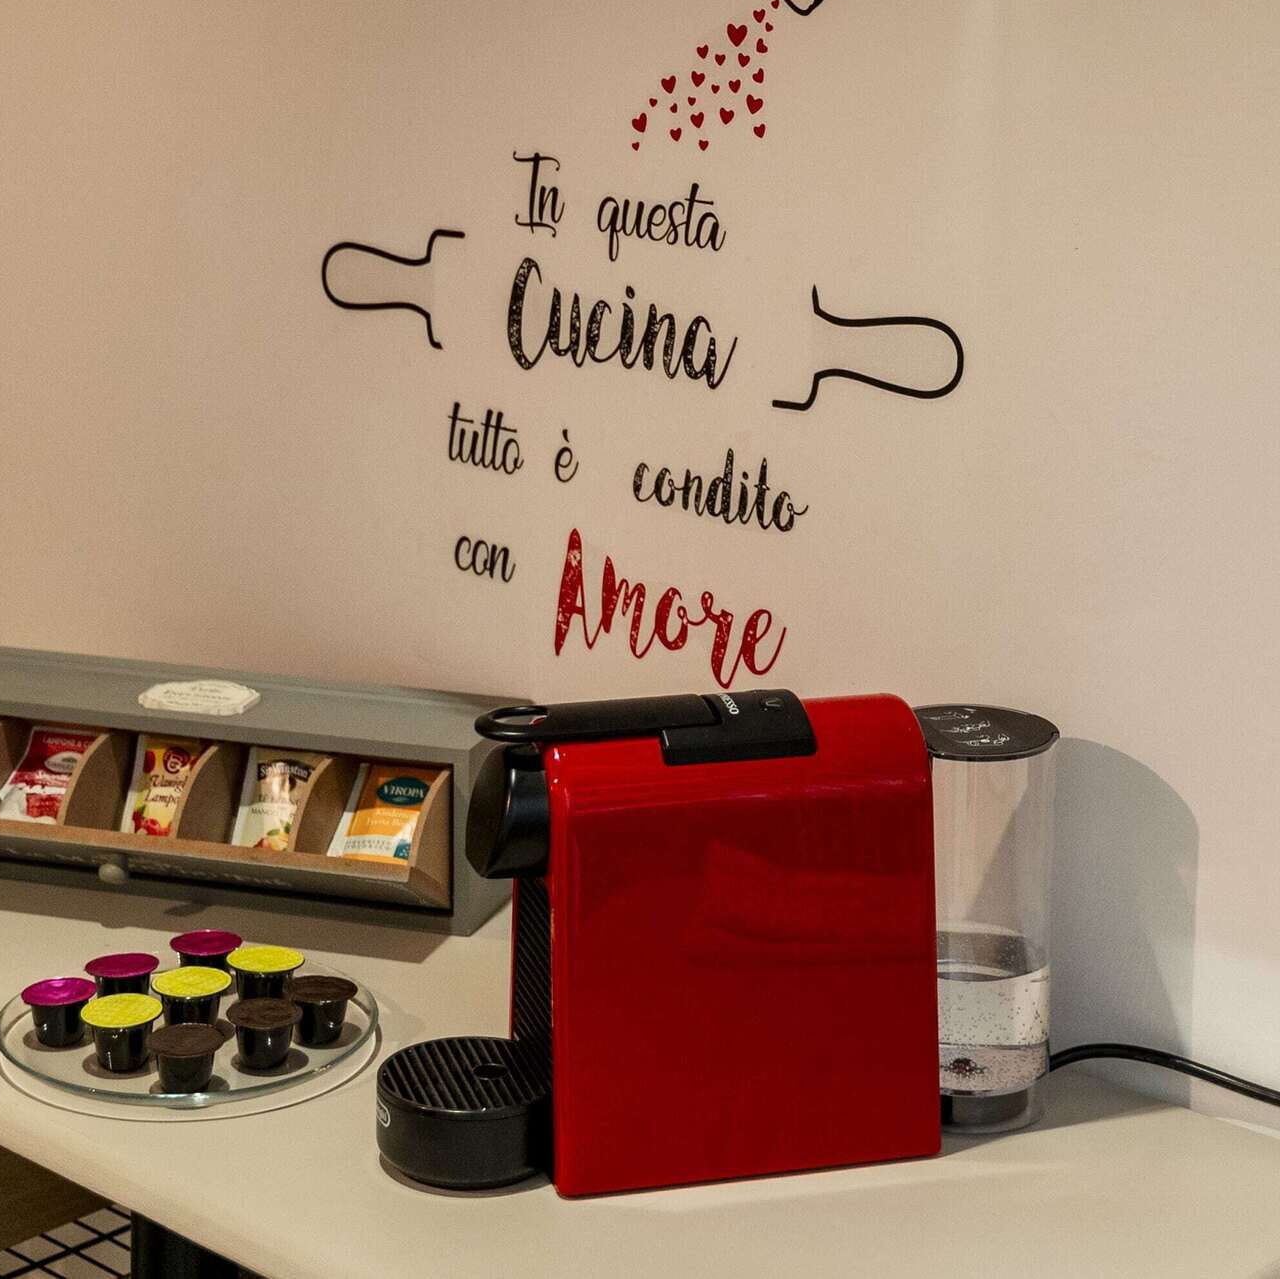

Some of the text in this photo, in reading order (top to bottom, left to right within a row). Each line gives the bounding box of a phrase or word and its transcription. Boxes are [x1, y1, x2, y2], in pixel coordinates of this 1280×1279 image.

[513, 151, 726, 262] In questa
[507, 256, 738, 390] Cucina
[447, 402, 810, 532] tutto è condito
[454, 528, 788, 690] con Amore
[383, 784, 424, 798] VIROPA
